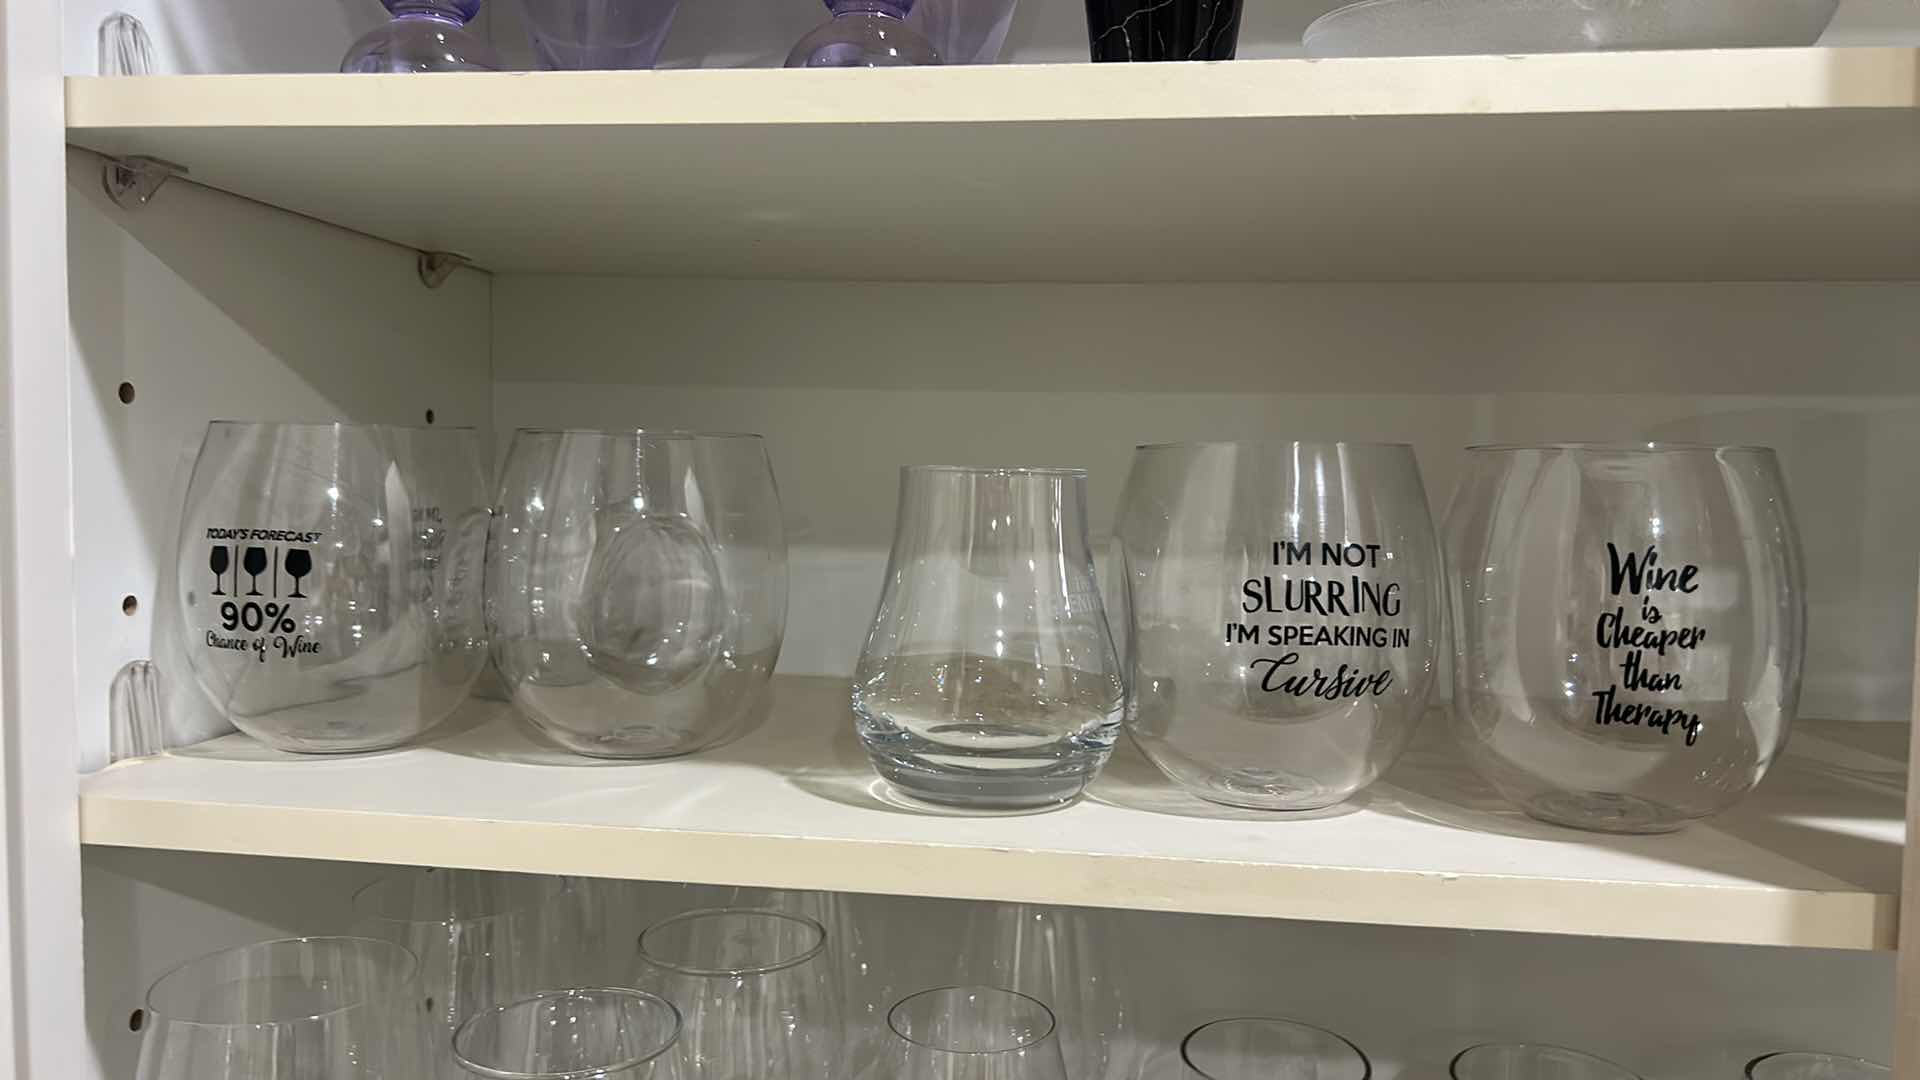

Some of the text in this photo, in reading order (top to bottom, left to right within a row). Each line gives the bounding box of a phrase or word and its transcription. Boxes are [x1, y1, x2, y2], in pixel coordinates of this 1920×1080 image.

[206, 528, 322, 543] TODAY'S FORECAST
[1273, 541, 1381, 568] I'M NOT
[1607, 542, 1699, 595] Wine
[1242, 575, 1401, 617] SLURRING
[1642, 595, 1663, 624] is
[220, 601, 296, 633] 90%
[1226, 623, 1410, 648] I'M SPEAKING IN
[1596, 606, 1706, 656] Cheaper
[206, 629, 322, 663] Chance of Wine
[1250, 652, 1393, 701] Cursive
[1619, 649, 1682, 692] than
[1592, 685, 1702, 747] Therapy
